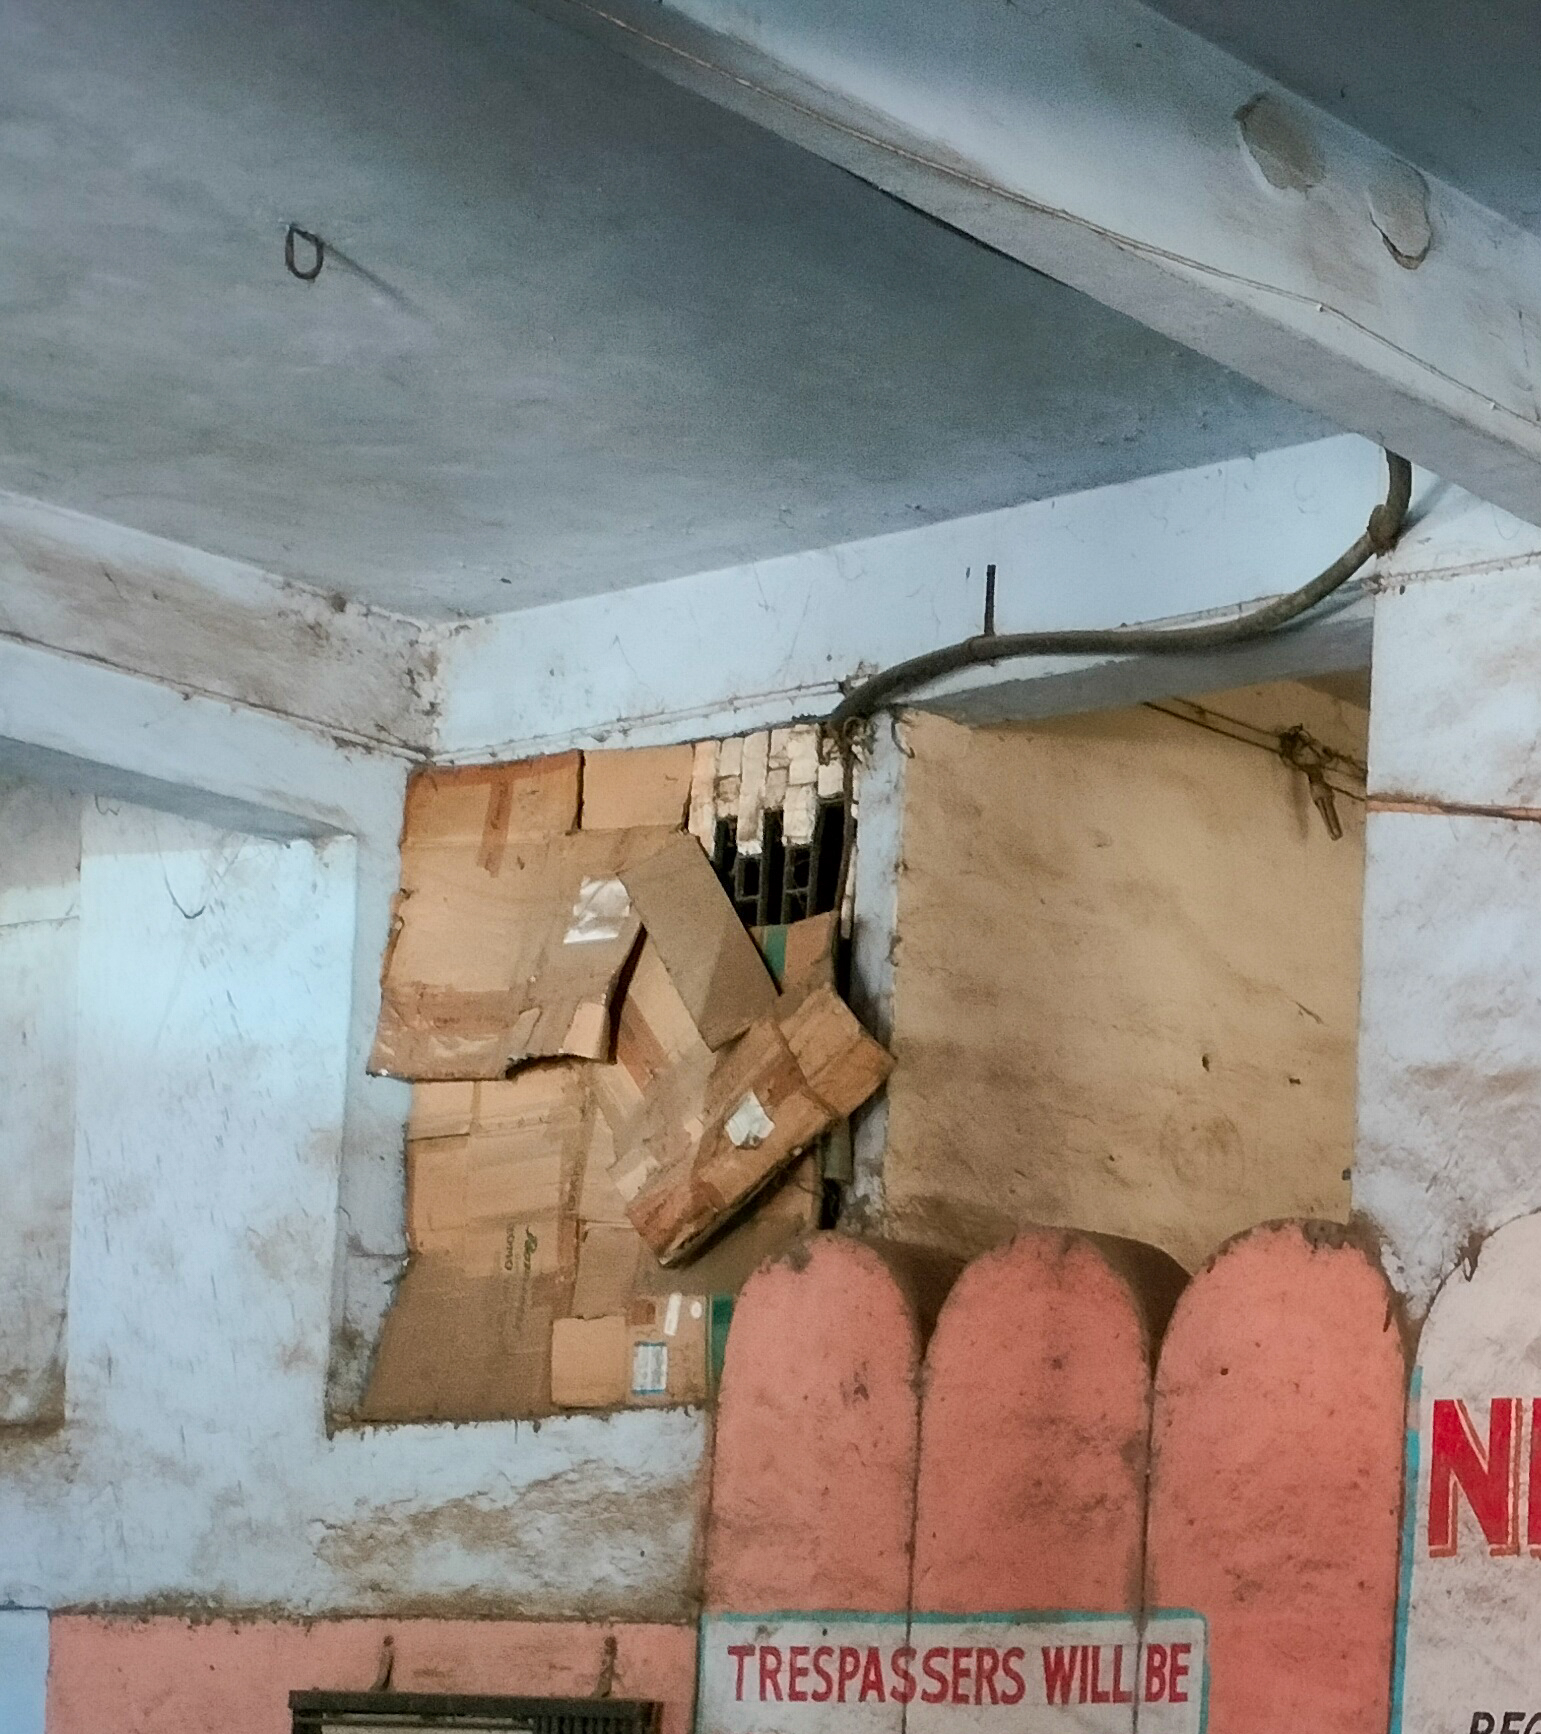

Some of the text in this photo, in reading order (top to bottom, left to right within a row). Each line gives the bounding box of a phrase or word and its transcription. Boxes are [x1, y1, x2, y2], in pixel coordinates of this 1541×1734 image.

[727, 1643, 1192, 1706] TRESPASSERS WILL BE
